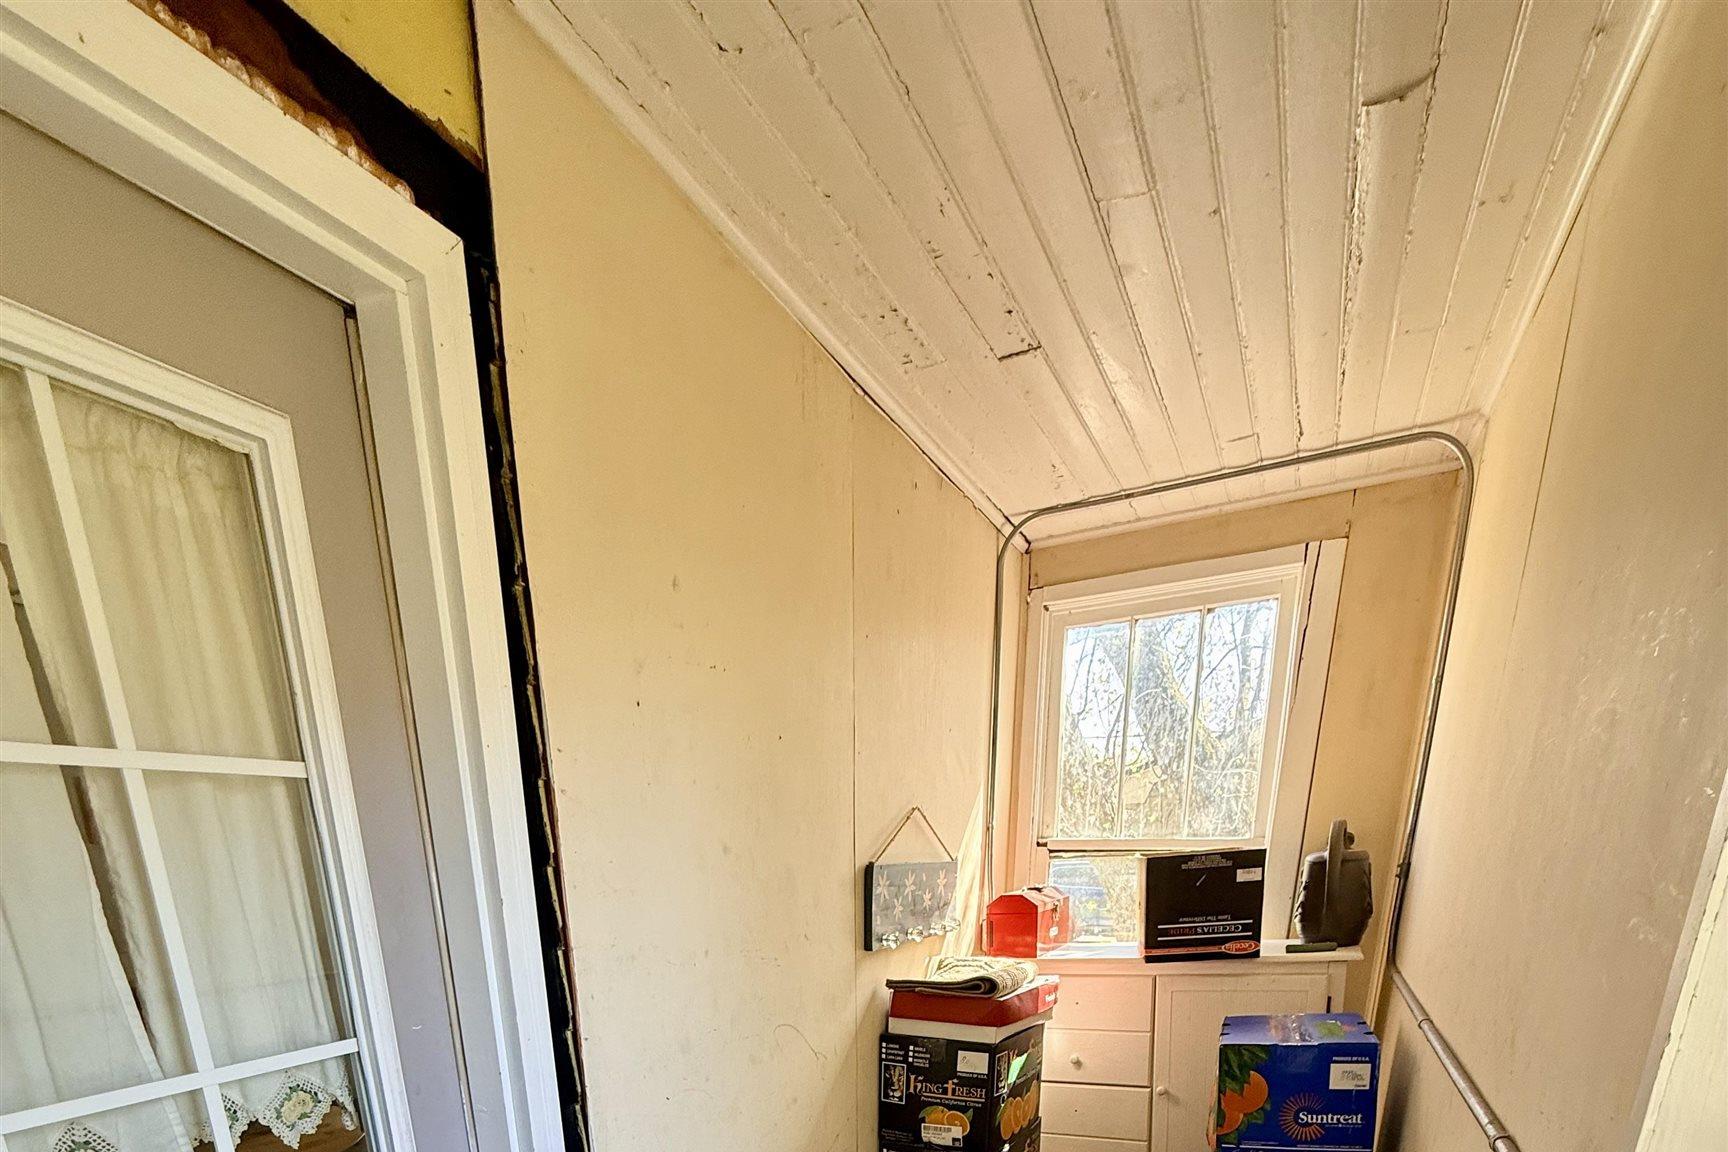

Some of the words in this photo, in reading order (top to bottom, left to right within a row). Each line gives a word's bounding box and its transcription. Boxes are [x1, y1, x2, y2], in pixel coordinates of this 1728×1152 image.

[1196, 924, 1242, 934] CECELIA'S
[908, 1072, 942, 1096] KING
[943, 1079, 986, 1098] FRESH
[1298, 1111, 1363, 1124] Suntreat
